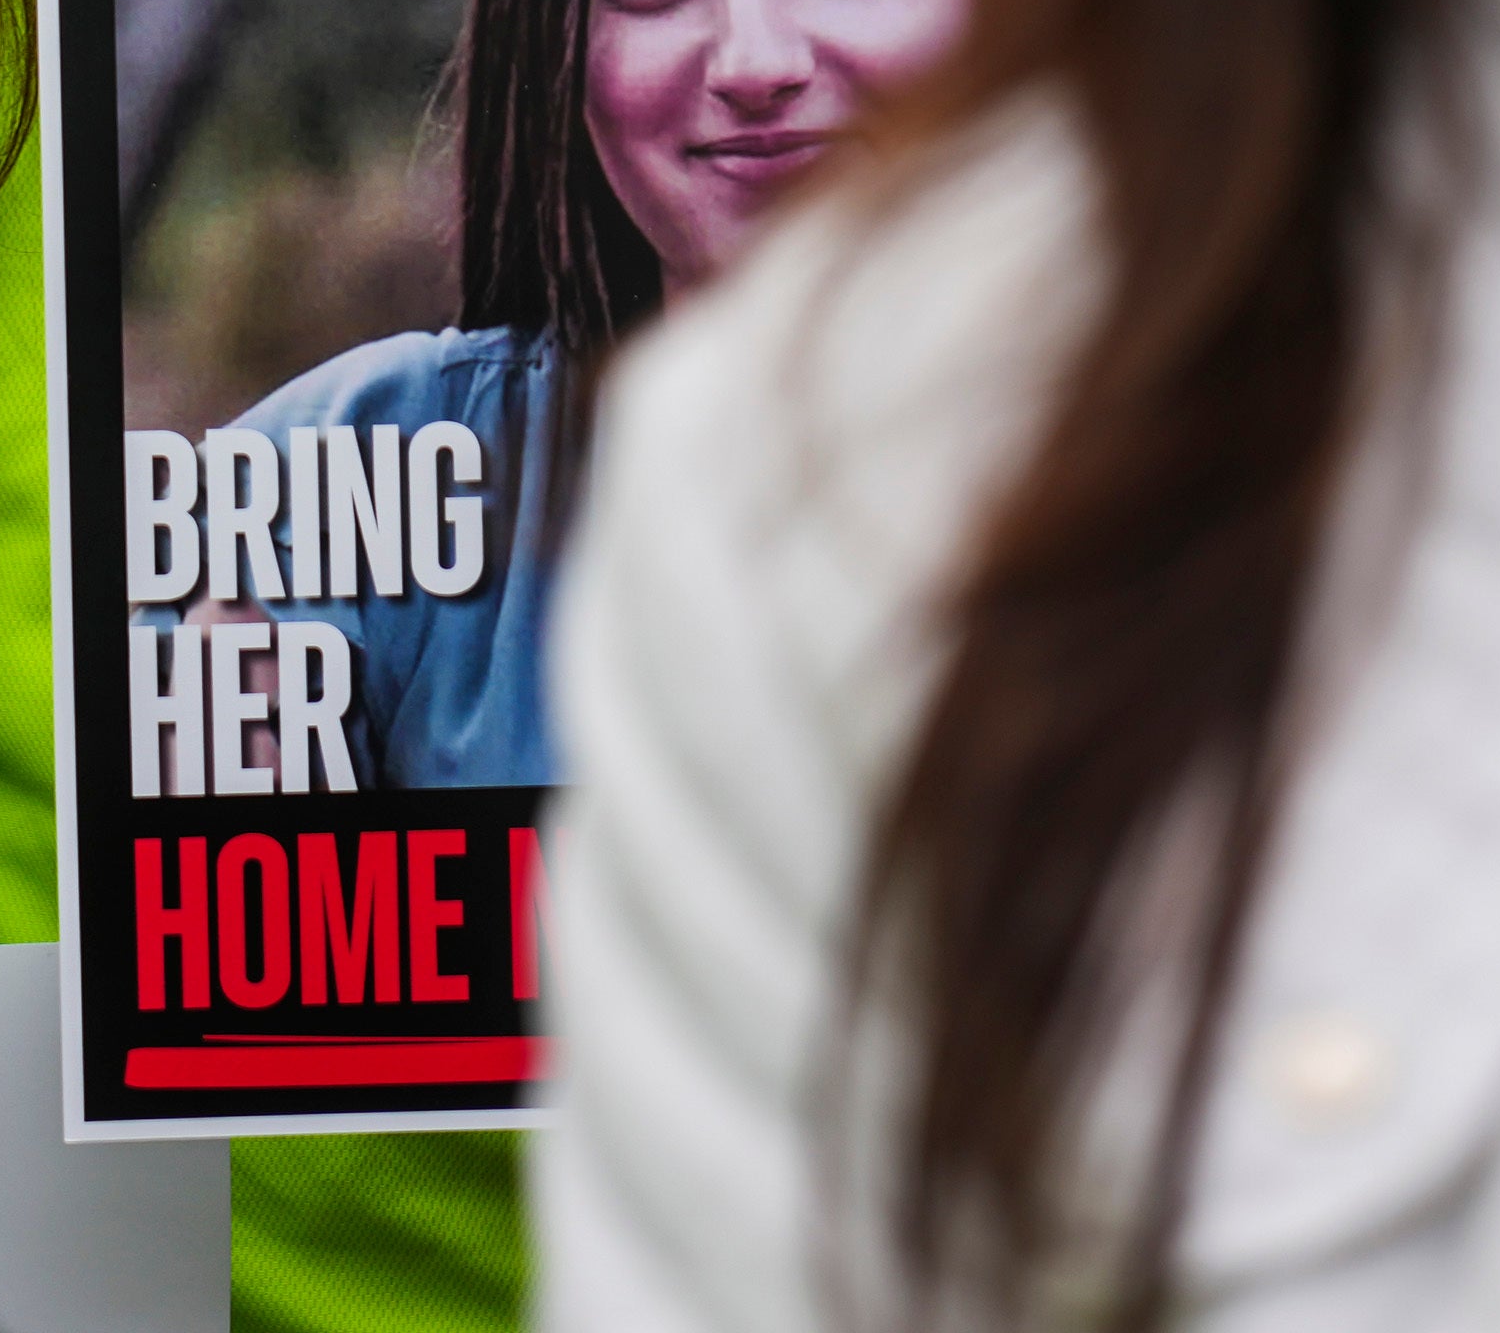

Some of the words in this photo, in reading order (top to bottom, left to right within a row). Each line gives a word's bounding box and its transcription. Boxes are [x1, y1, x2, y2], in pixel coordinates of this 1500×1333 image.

[124, 420, 484, 604] BRING
[128, 621, 360, 800] HER
[133, 828, 472, 1013] HOME
